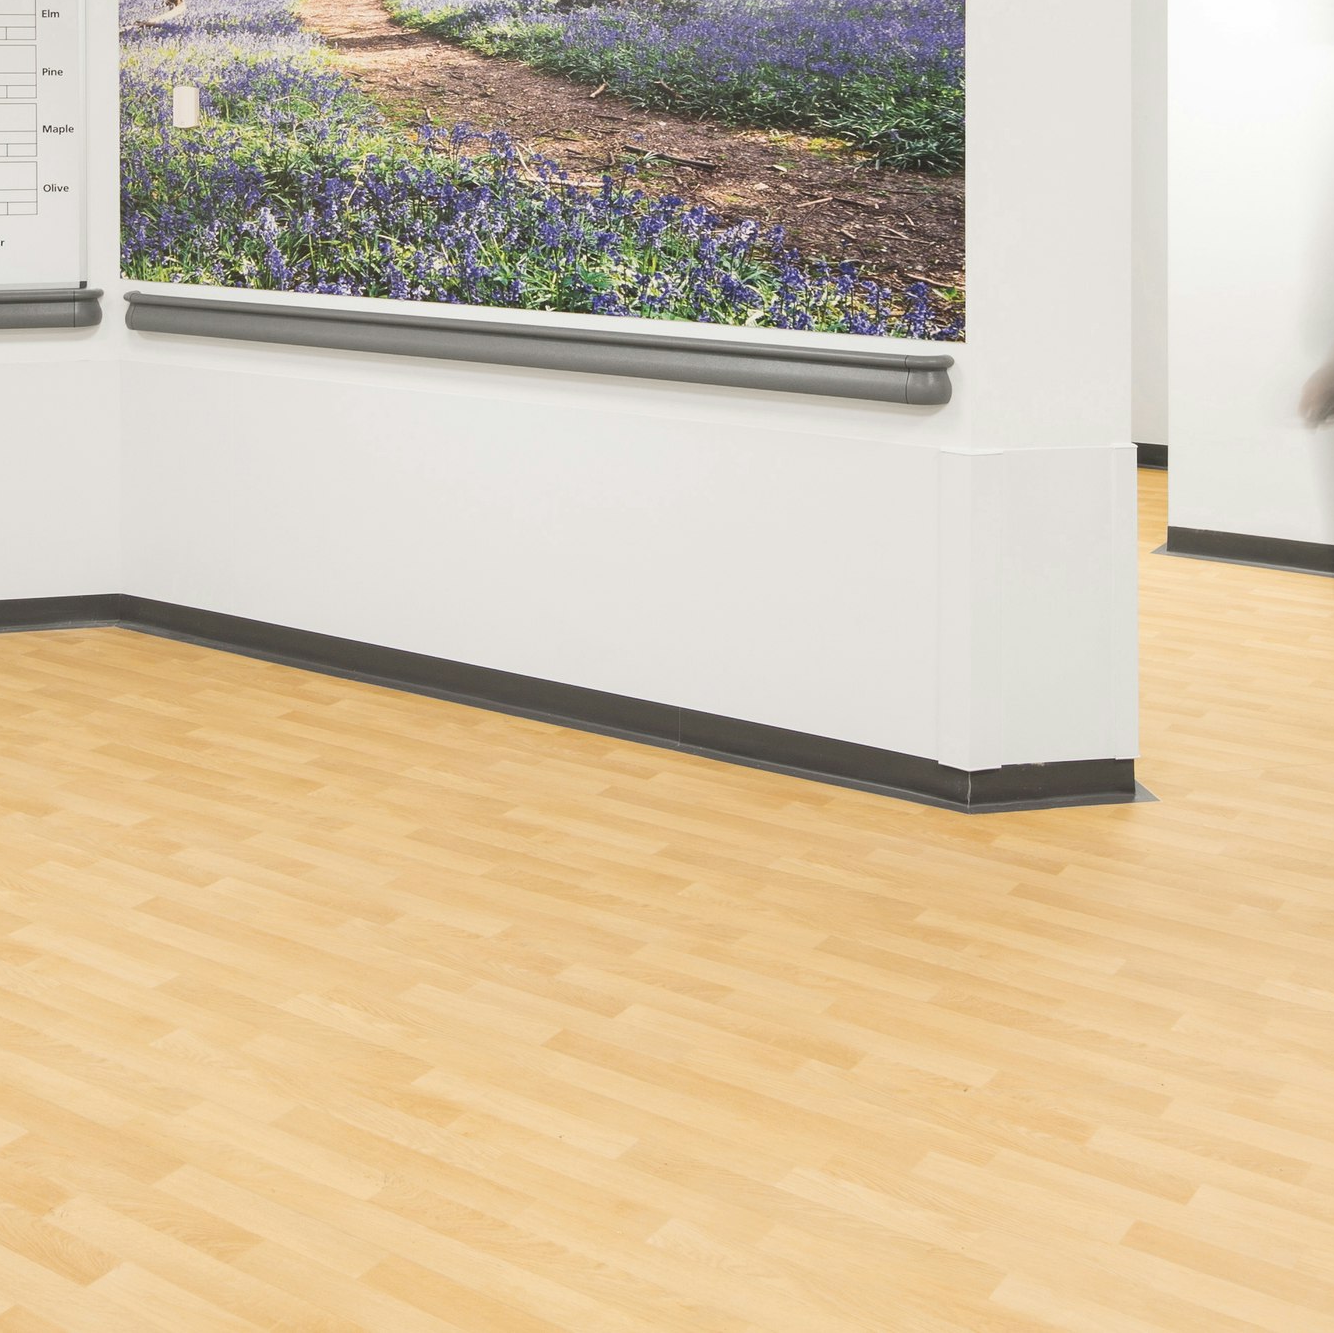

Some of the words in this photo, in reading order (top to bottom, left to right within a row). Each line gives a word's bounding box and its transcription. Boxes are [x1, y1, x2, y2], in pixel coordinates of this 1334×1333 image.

[41, 9, 60, 19] Elm
[42, 67, 64, 77] Pine
[42, 124, 75, 136] Maple
[42, 183, 70, 193] Olive
